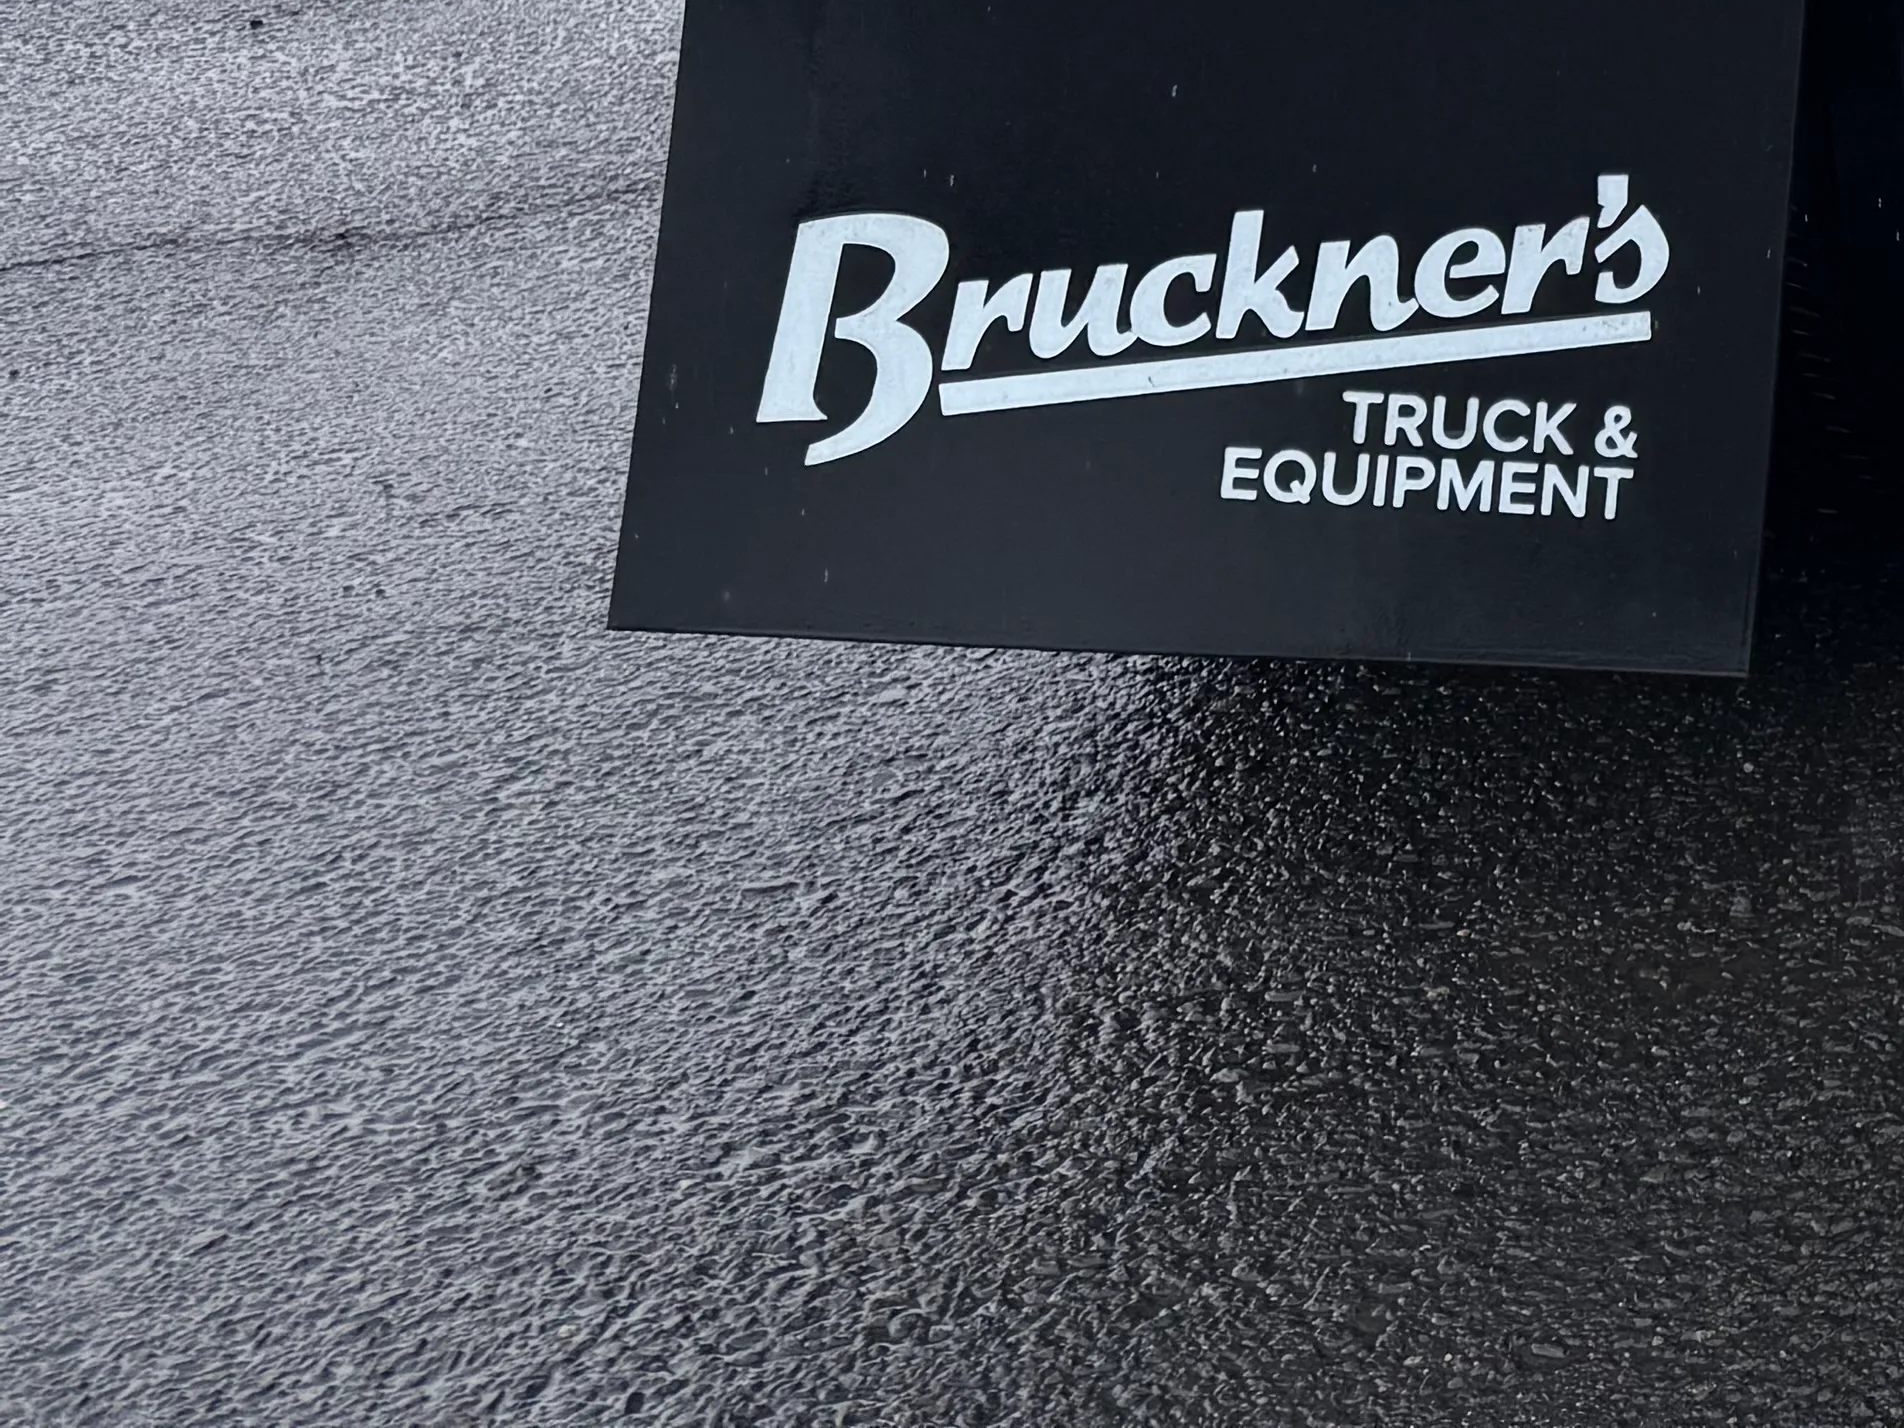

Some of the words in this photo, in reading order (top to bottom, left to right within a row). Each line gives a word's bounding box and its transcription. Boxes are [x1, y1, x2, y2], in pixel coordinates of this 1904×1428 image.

[756, 174, 1670, 466] Bruckner's
[1342, 390, 1577, 455] TRUCK
[1594, 405, 1638, 459] &
[1220, 446, 1635, 520] EQUIPMENT
